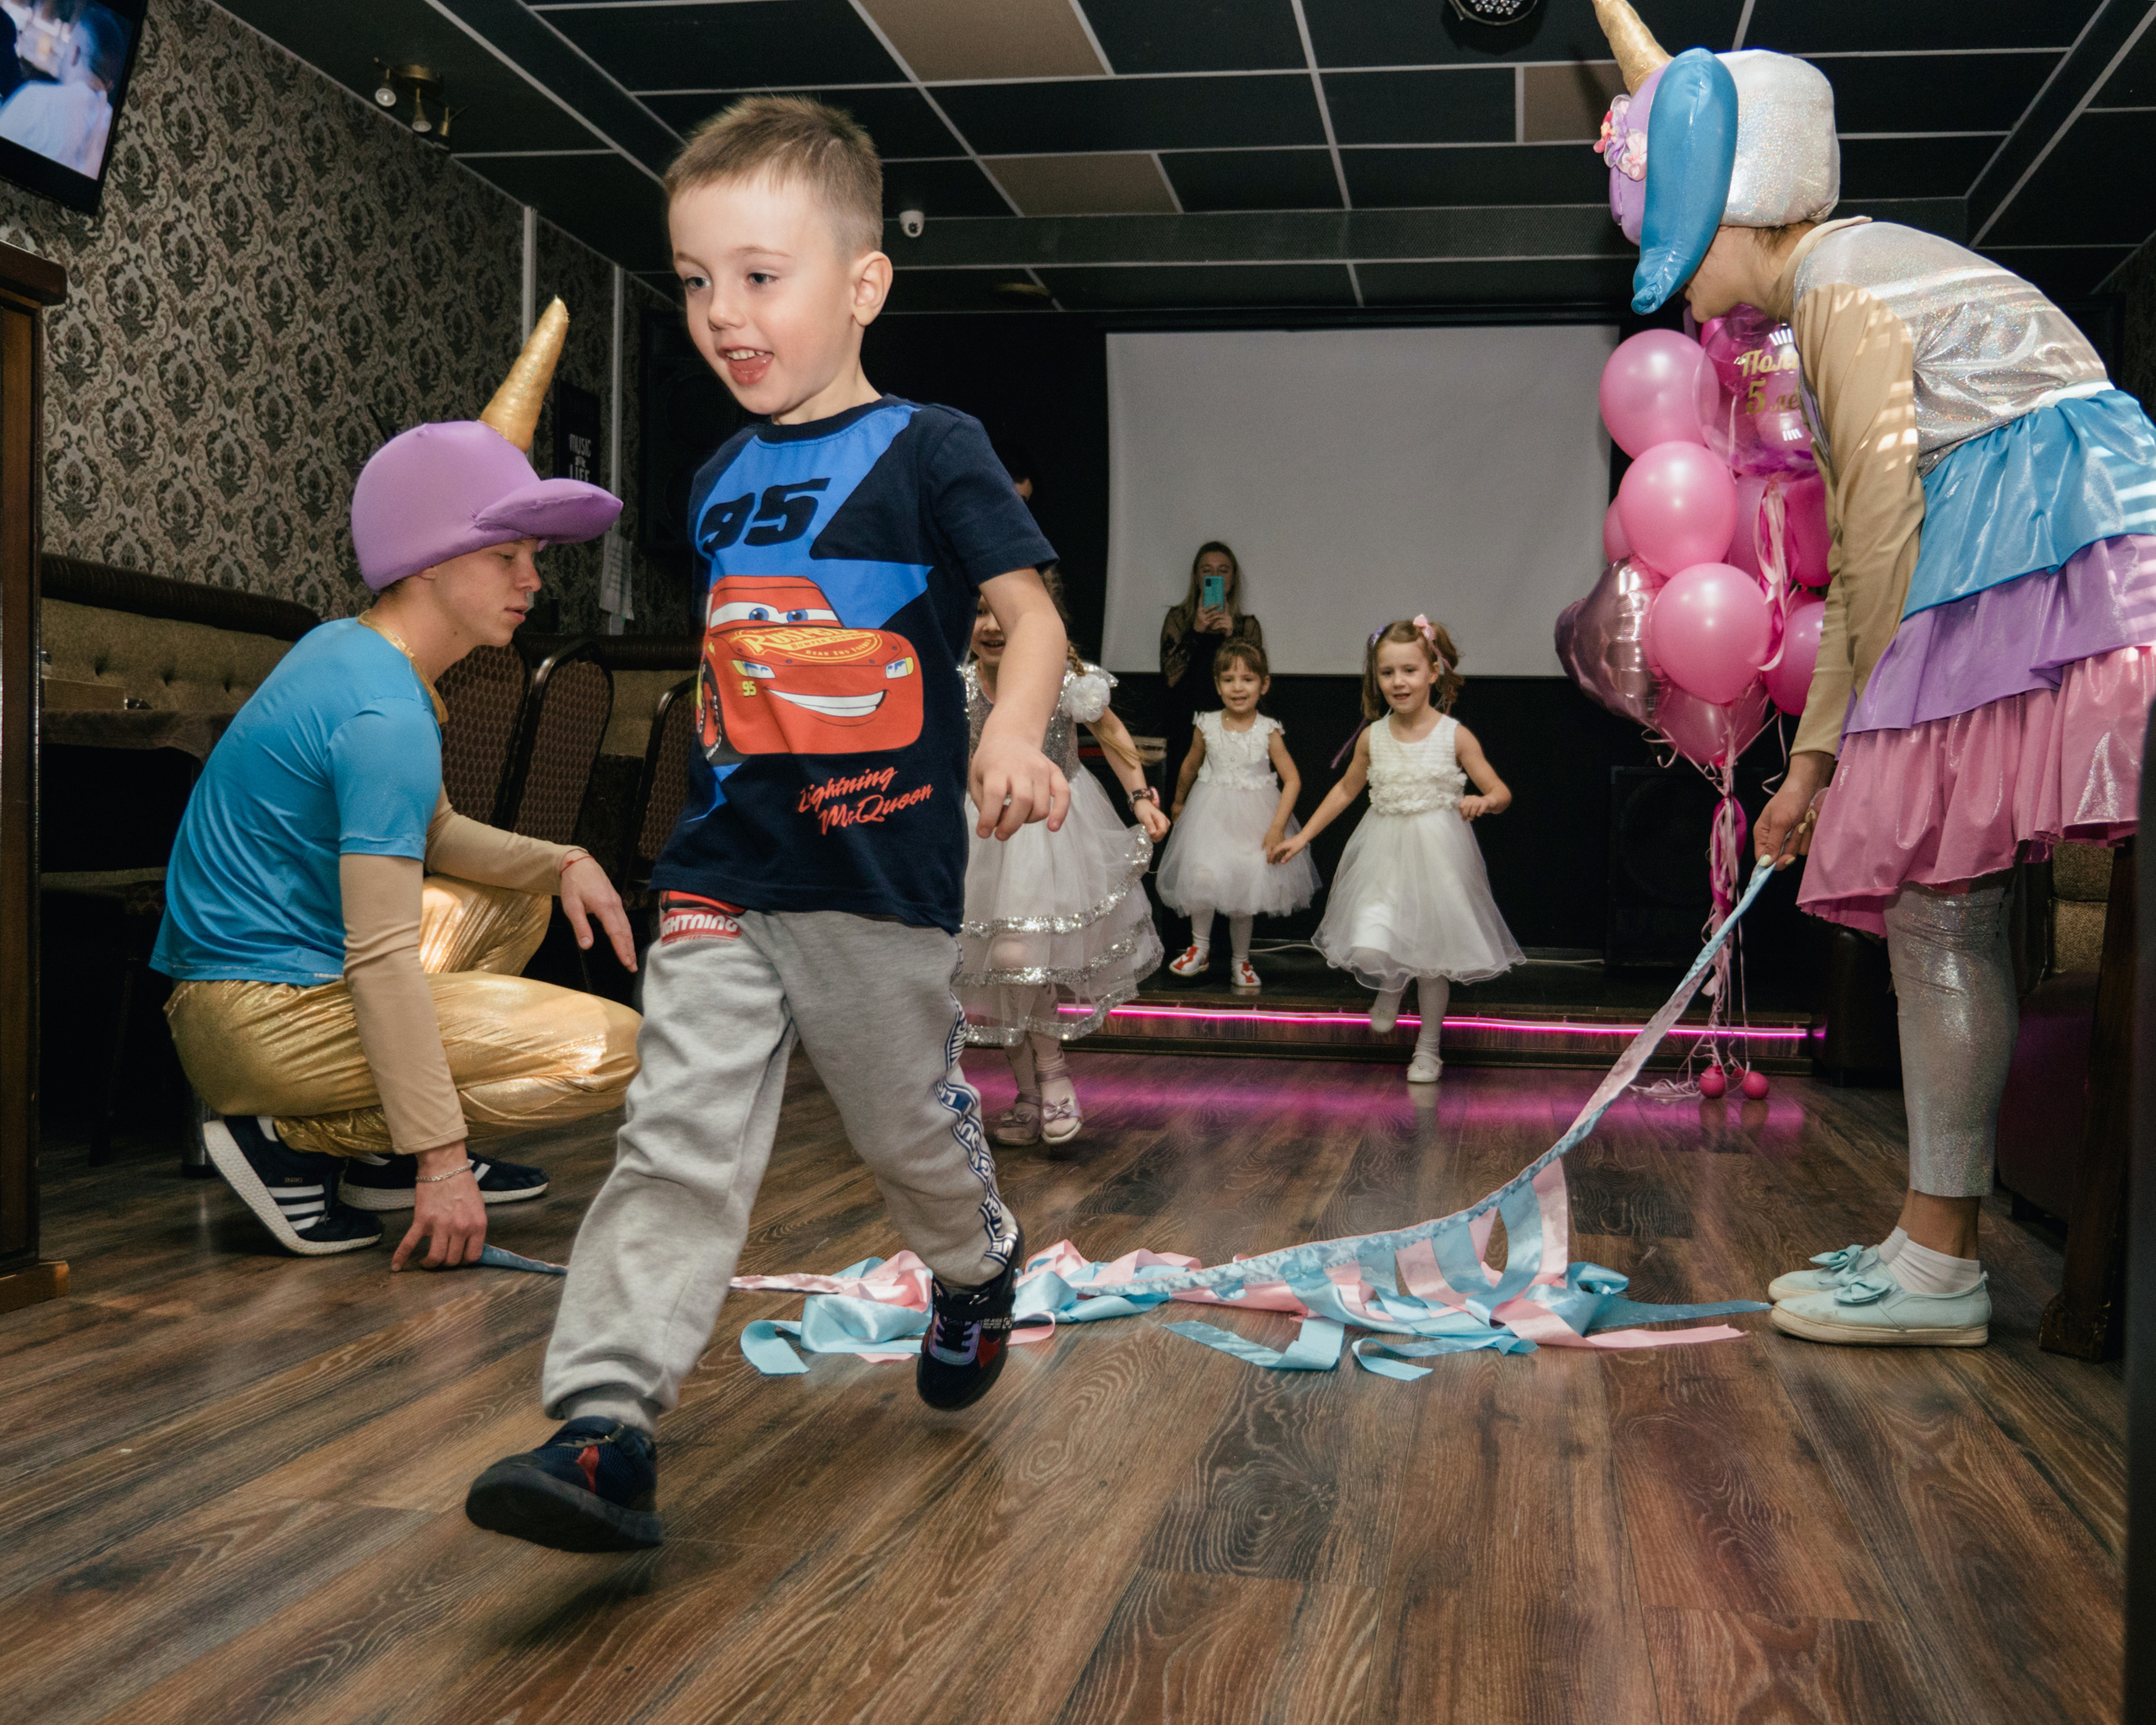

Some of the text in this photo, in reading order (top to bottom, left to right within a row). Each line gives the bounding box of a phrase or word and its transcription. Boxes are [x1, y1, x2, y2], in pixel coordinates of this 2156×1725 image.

[1746, 379, 1800, 414] 5 ле
[698, 477, 832, 553] 95
[742, 681, 757, 697] 95
[798, 766, 899, 814] Lightning
